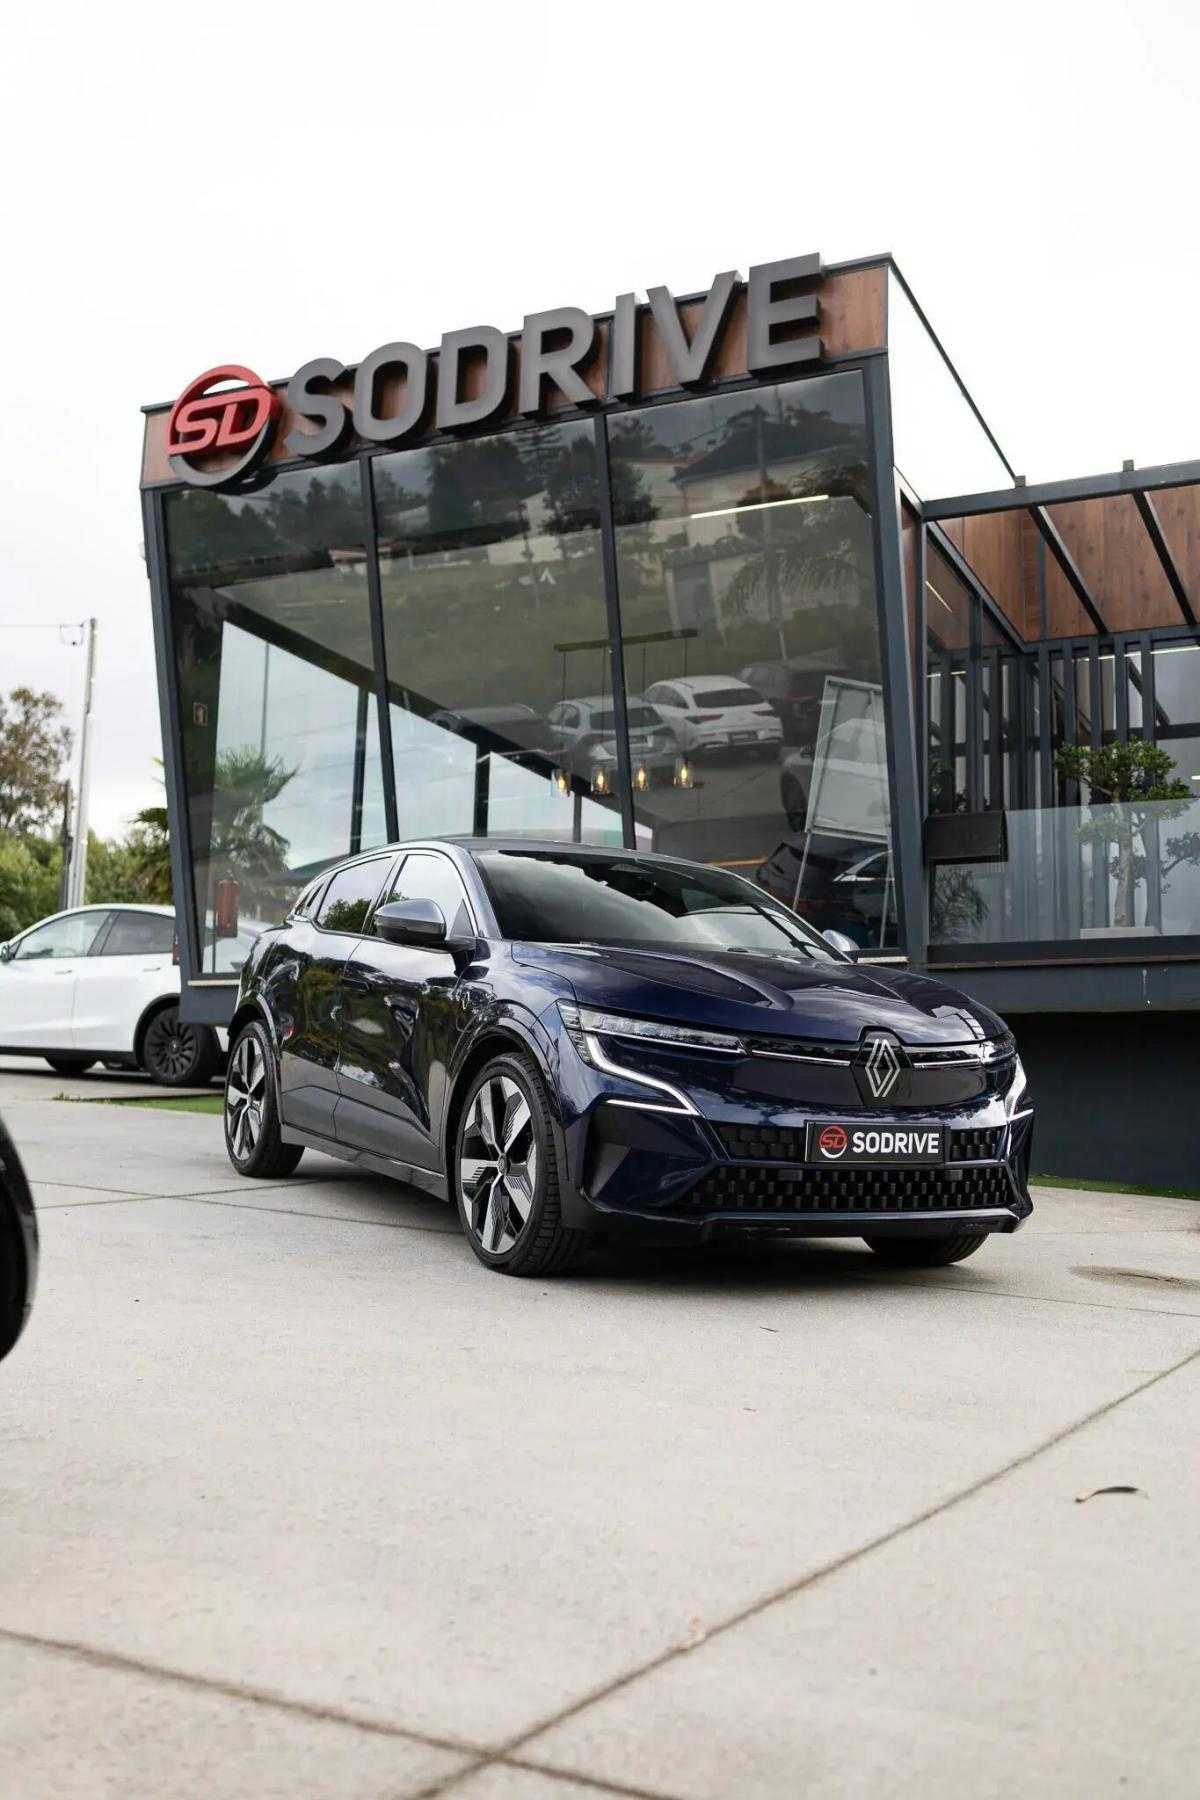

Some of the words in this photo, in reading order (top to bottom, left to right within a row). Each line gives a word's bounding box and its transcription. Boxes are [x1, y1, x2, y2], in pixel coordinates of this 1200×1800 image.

[166, 385, 273, 456] SD
[283, 252, 822, 457] SODRIVE
[852, 1132, 940, 1154] SODRIVE
